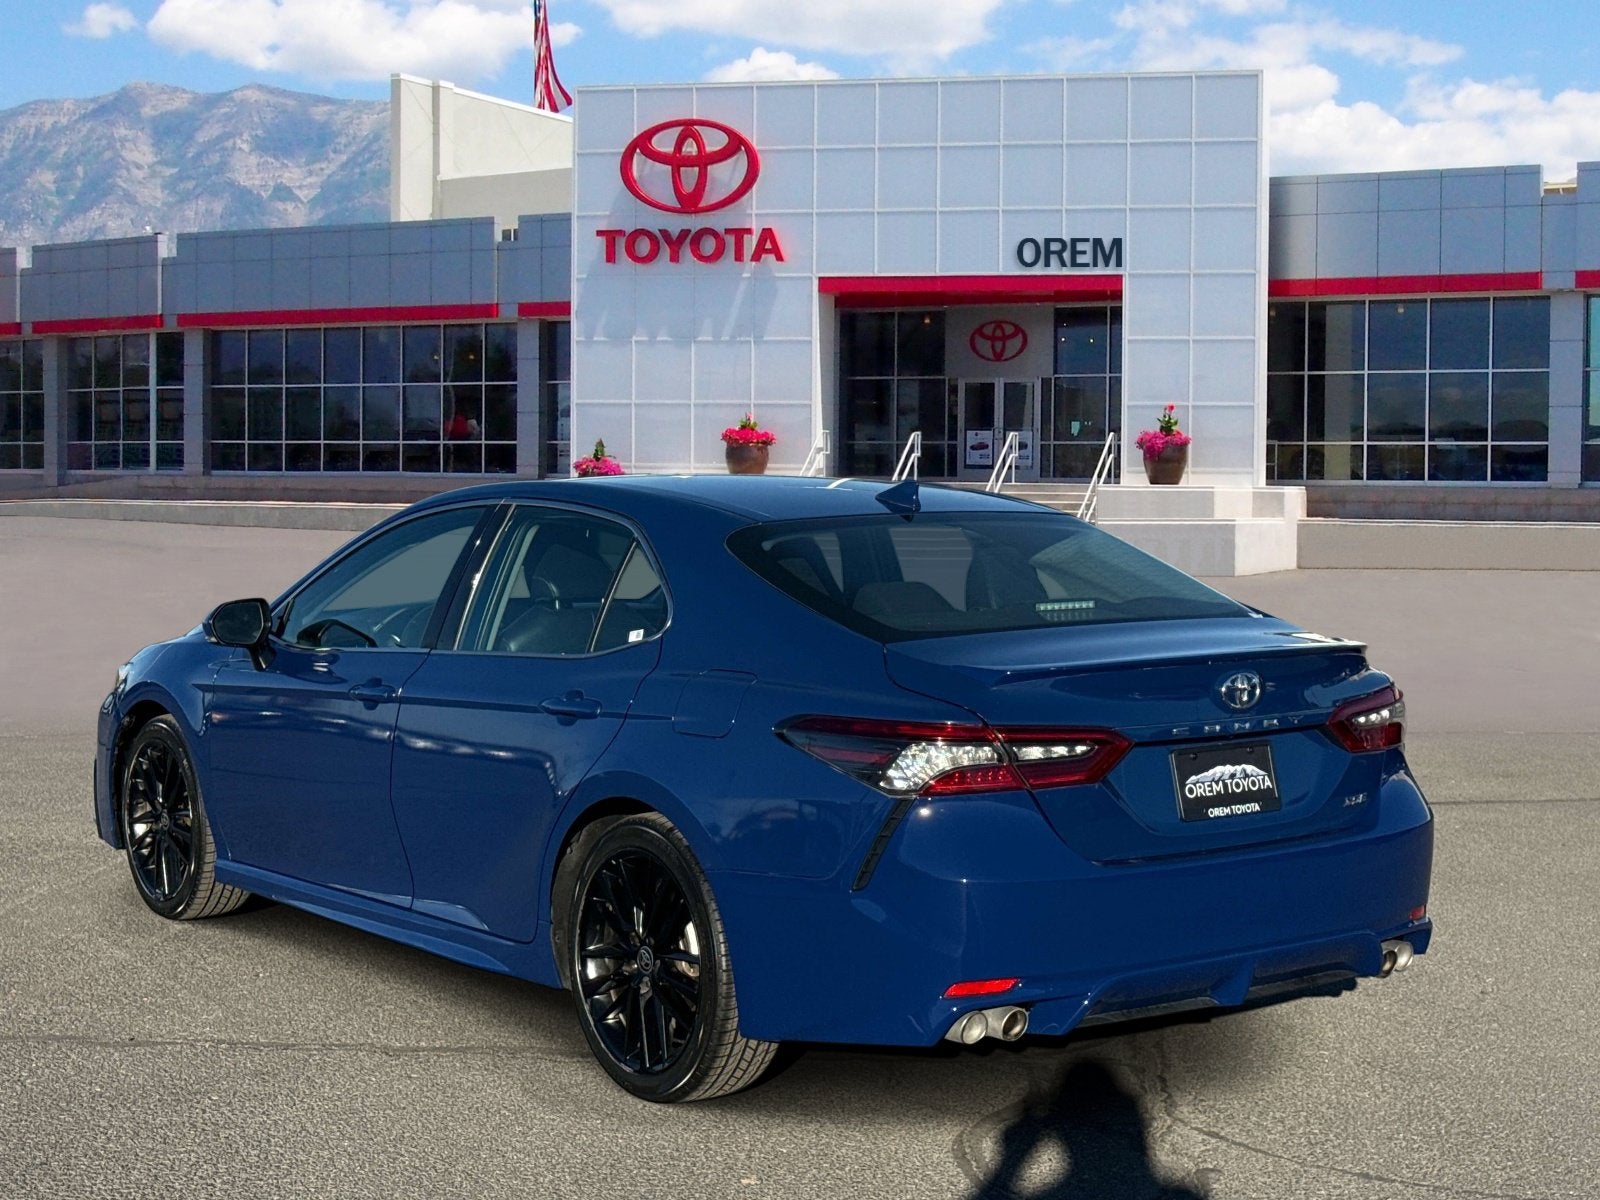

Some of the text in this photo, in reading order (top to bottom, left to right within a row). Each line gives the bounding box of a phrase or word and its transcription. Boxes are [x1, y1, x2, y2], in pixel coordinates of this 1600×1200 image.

[596, 227, 785, 264] TOYOTA
[1016, 237, 1123, 268] OREM
[1185, 775, 1273, 798] OREM TOYOTA
[1208, 802, 1261, 818] OREM TOYOTA
